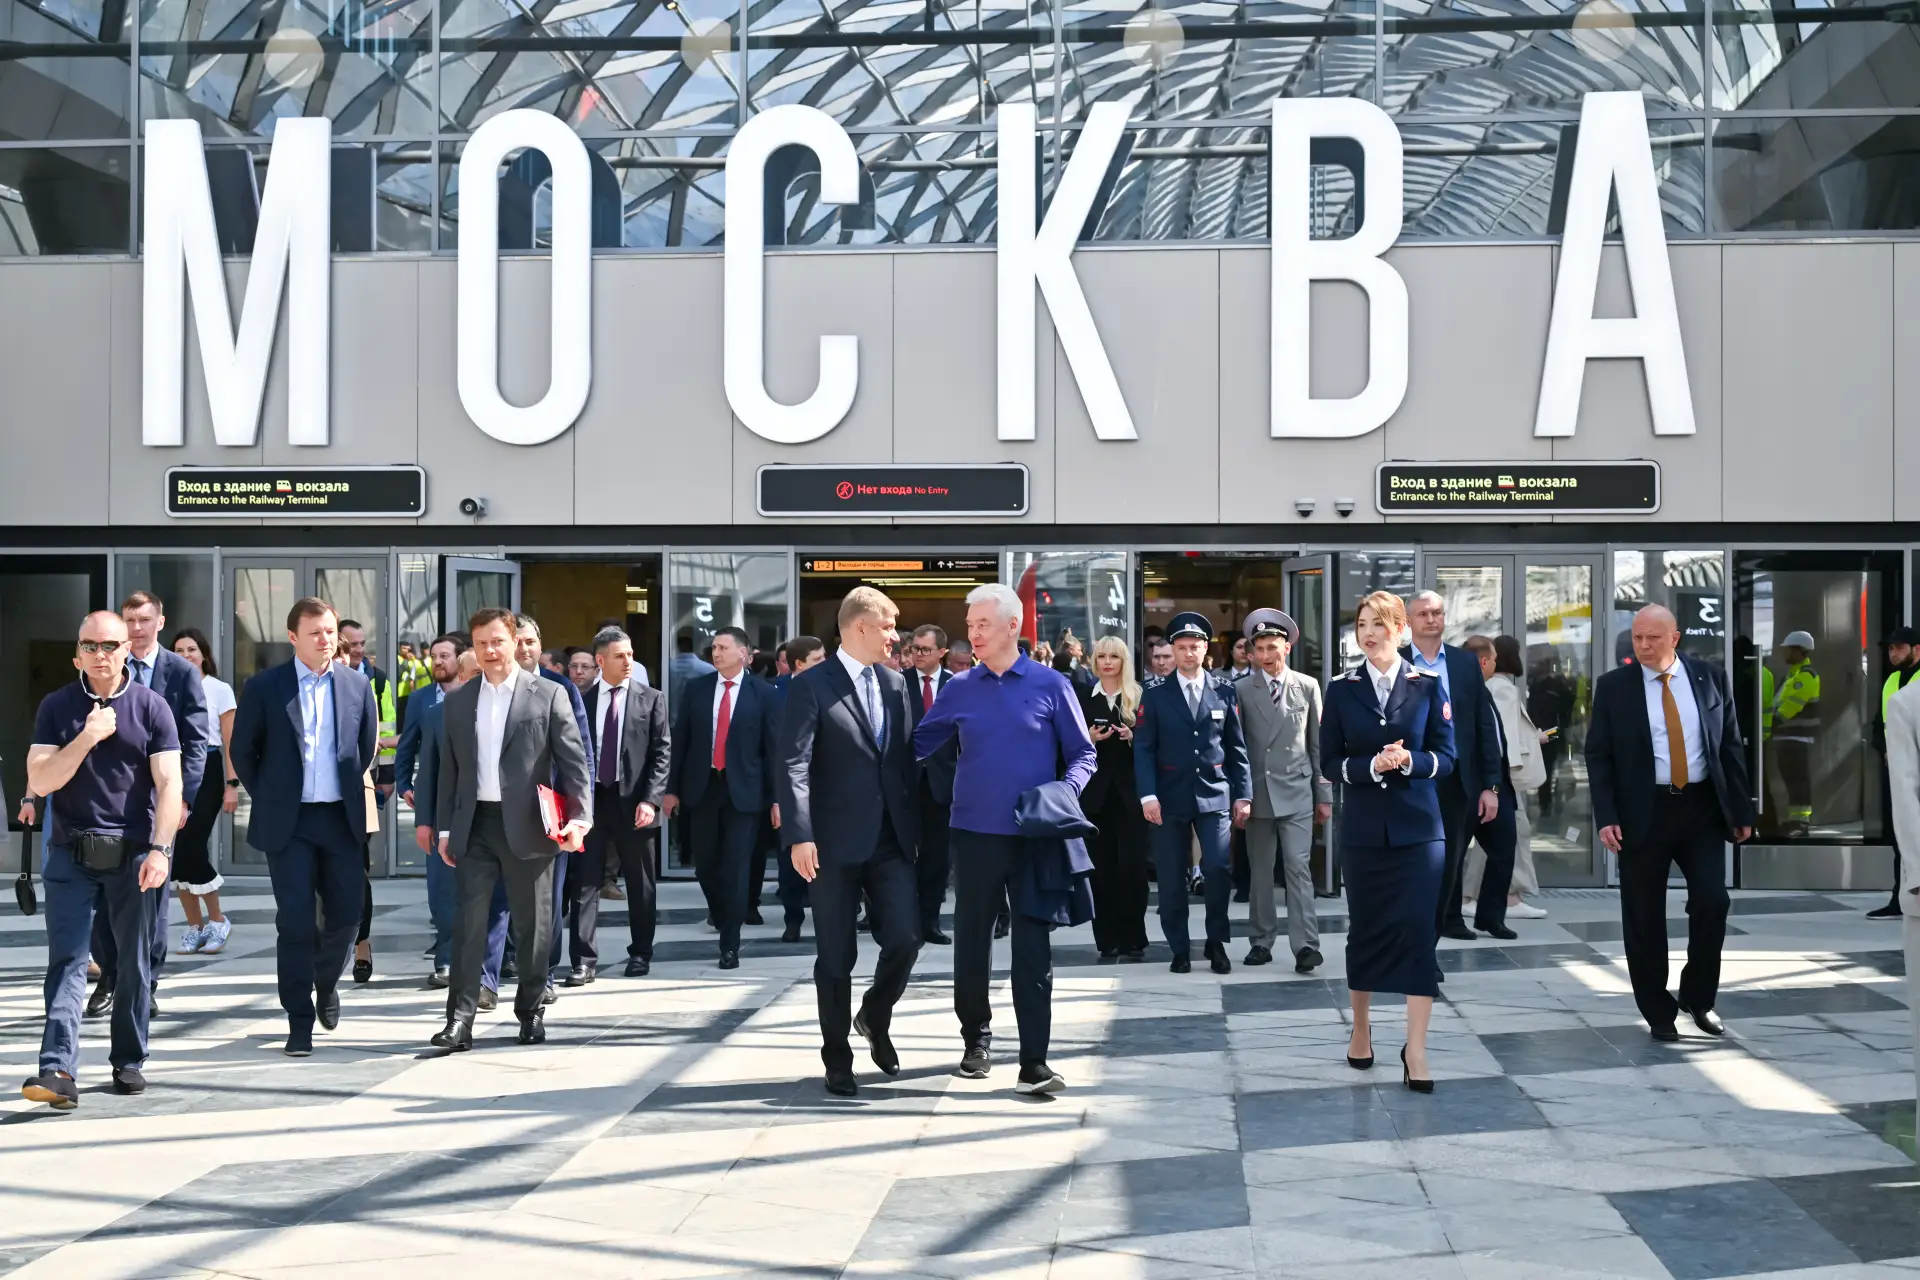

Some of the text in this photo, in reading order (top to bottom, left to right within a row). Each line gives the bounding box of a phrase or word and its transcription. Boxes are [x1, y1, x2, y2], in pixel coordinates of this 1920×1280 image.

[142, 91, 1697, 446] МОСКВА
[177, 480, 349, 493] Вход в здание вокзала
[1390, 475, 1577, 490] Вход в здание вокзала
[857, 484, 949, 496] Нет входа No Entry
[177, 495, 328, 506] Entrance to the Railway Terminal
[1390, 491, 1554, 502] Entrance to the Railway Terminal
